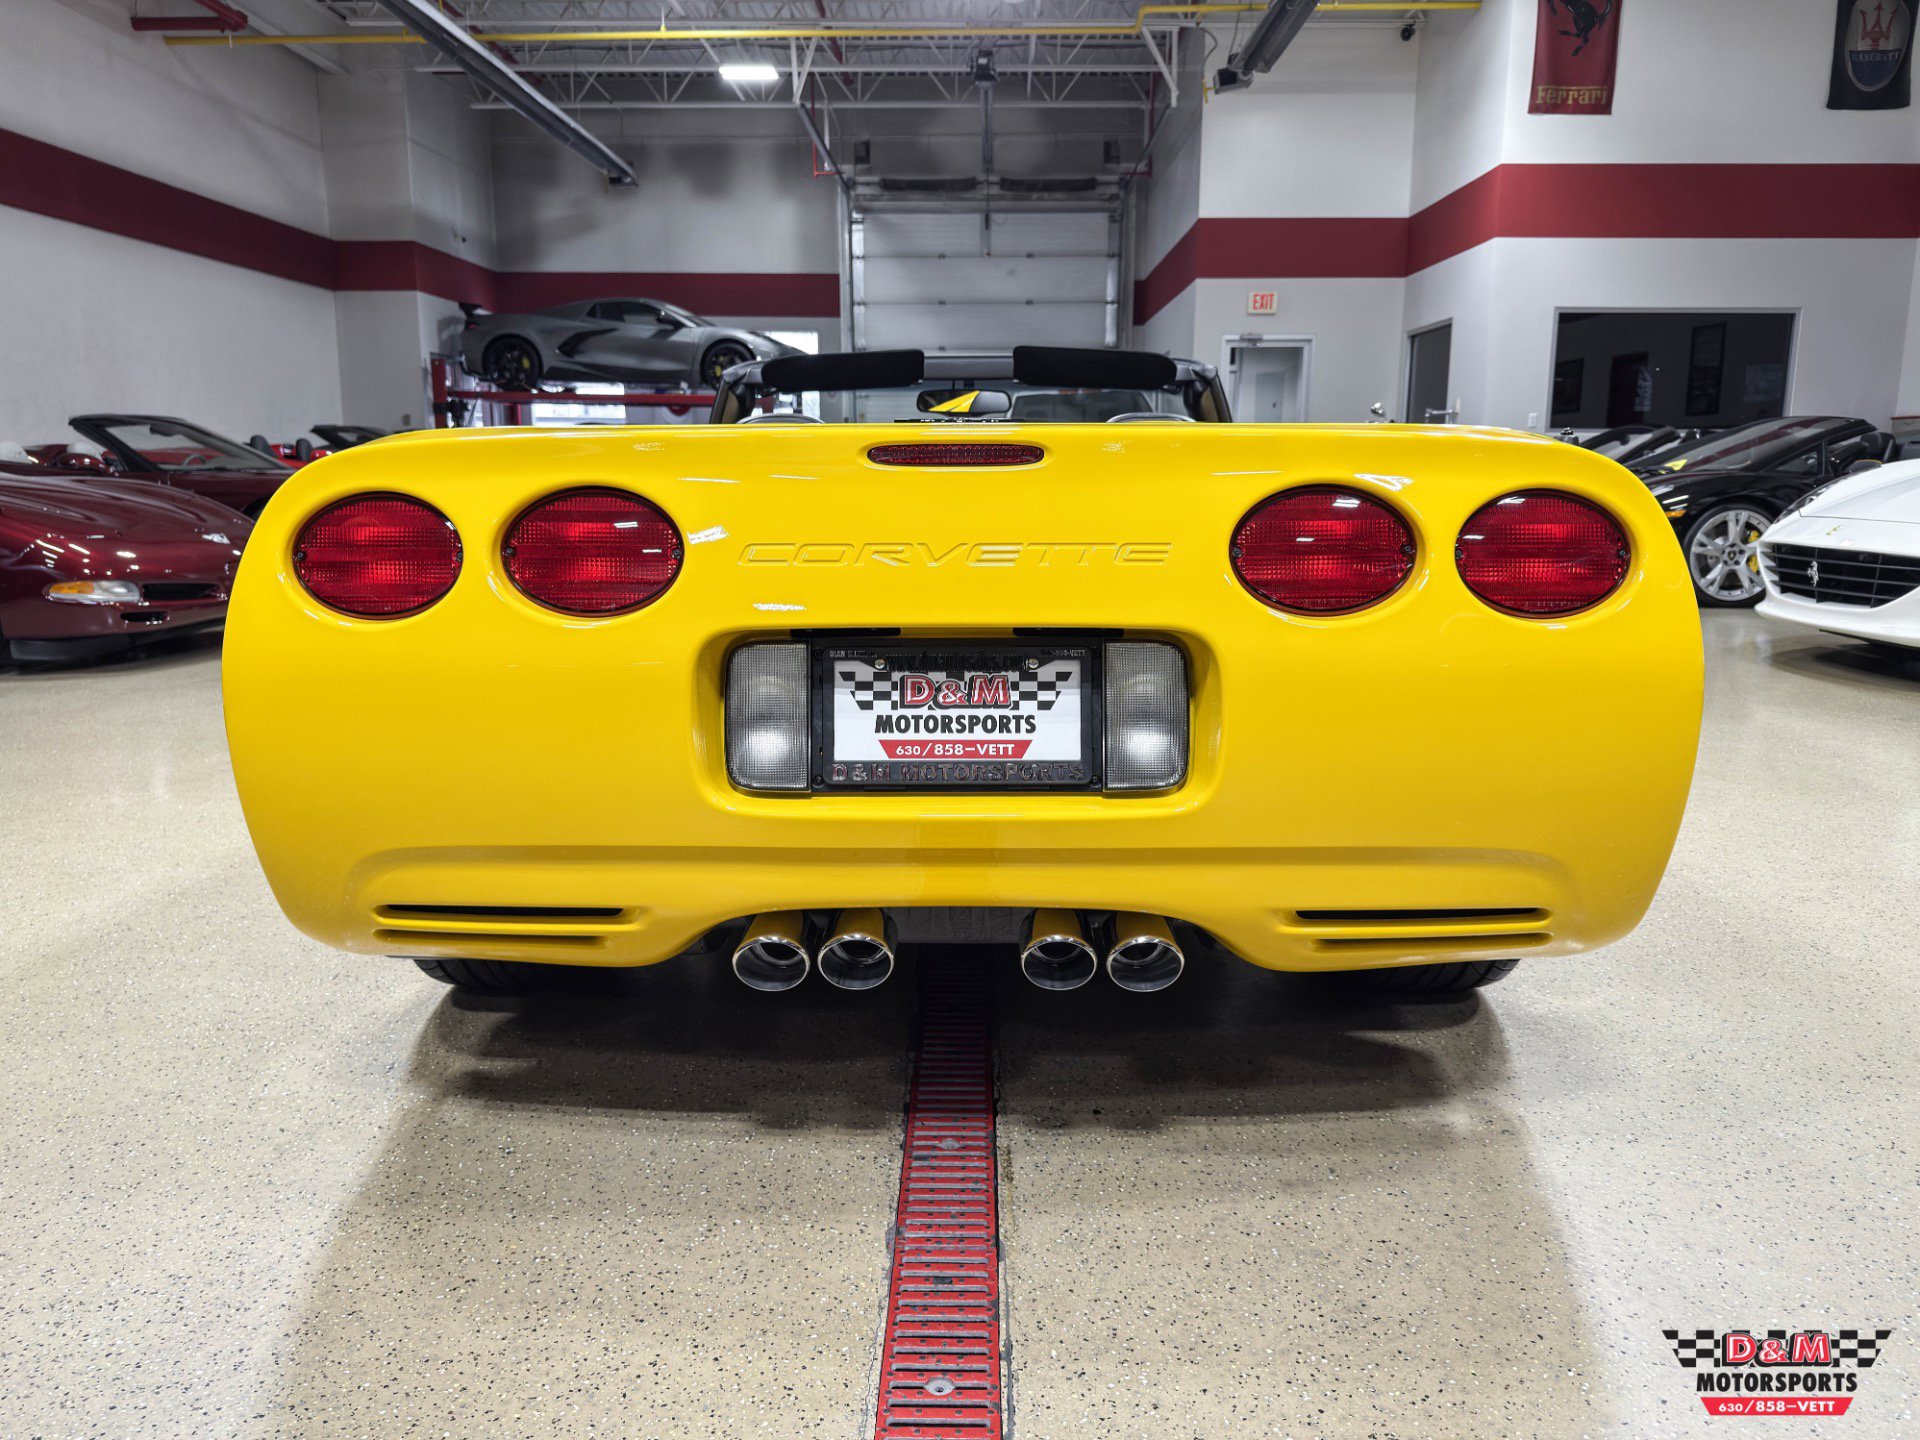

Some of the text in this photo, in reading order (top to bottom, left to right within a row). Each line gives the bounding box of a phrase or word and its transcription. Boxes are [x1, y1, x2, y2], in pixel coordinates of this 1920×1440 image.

[1536, 86, 1608, 104] Ferrari
[1252, 293, 1274, 310] EXIT
[737, 542, 1174, 567] CORVETTE
[901, 674, 1011, 708] D&M
[875, 714, 1036, 734] MOTORSPORTS
[901, 763, 1084, 781] MOTORSPORTS
